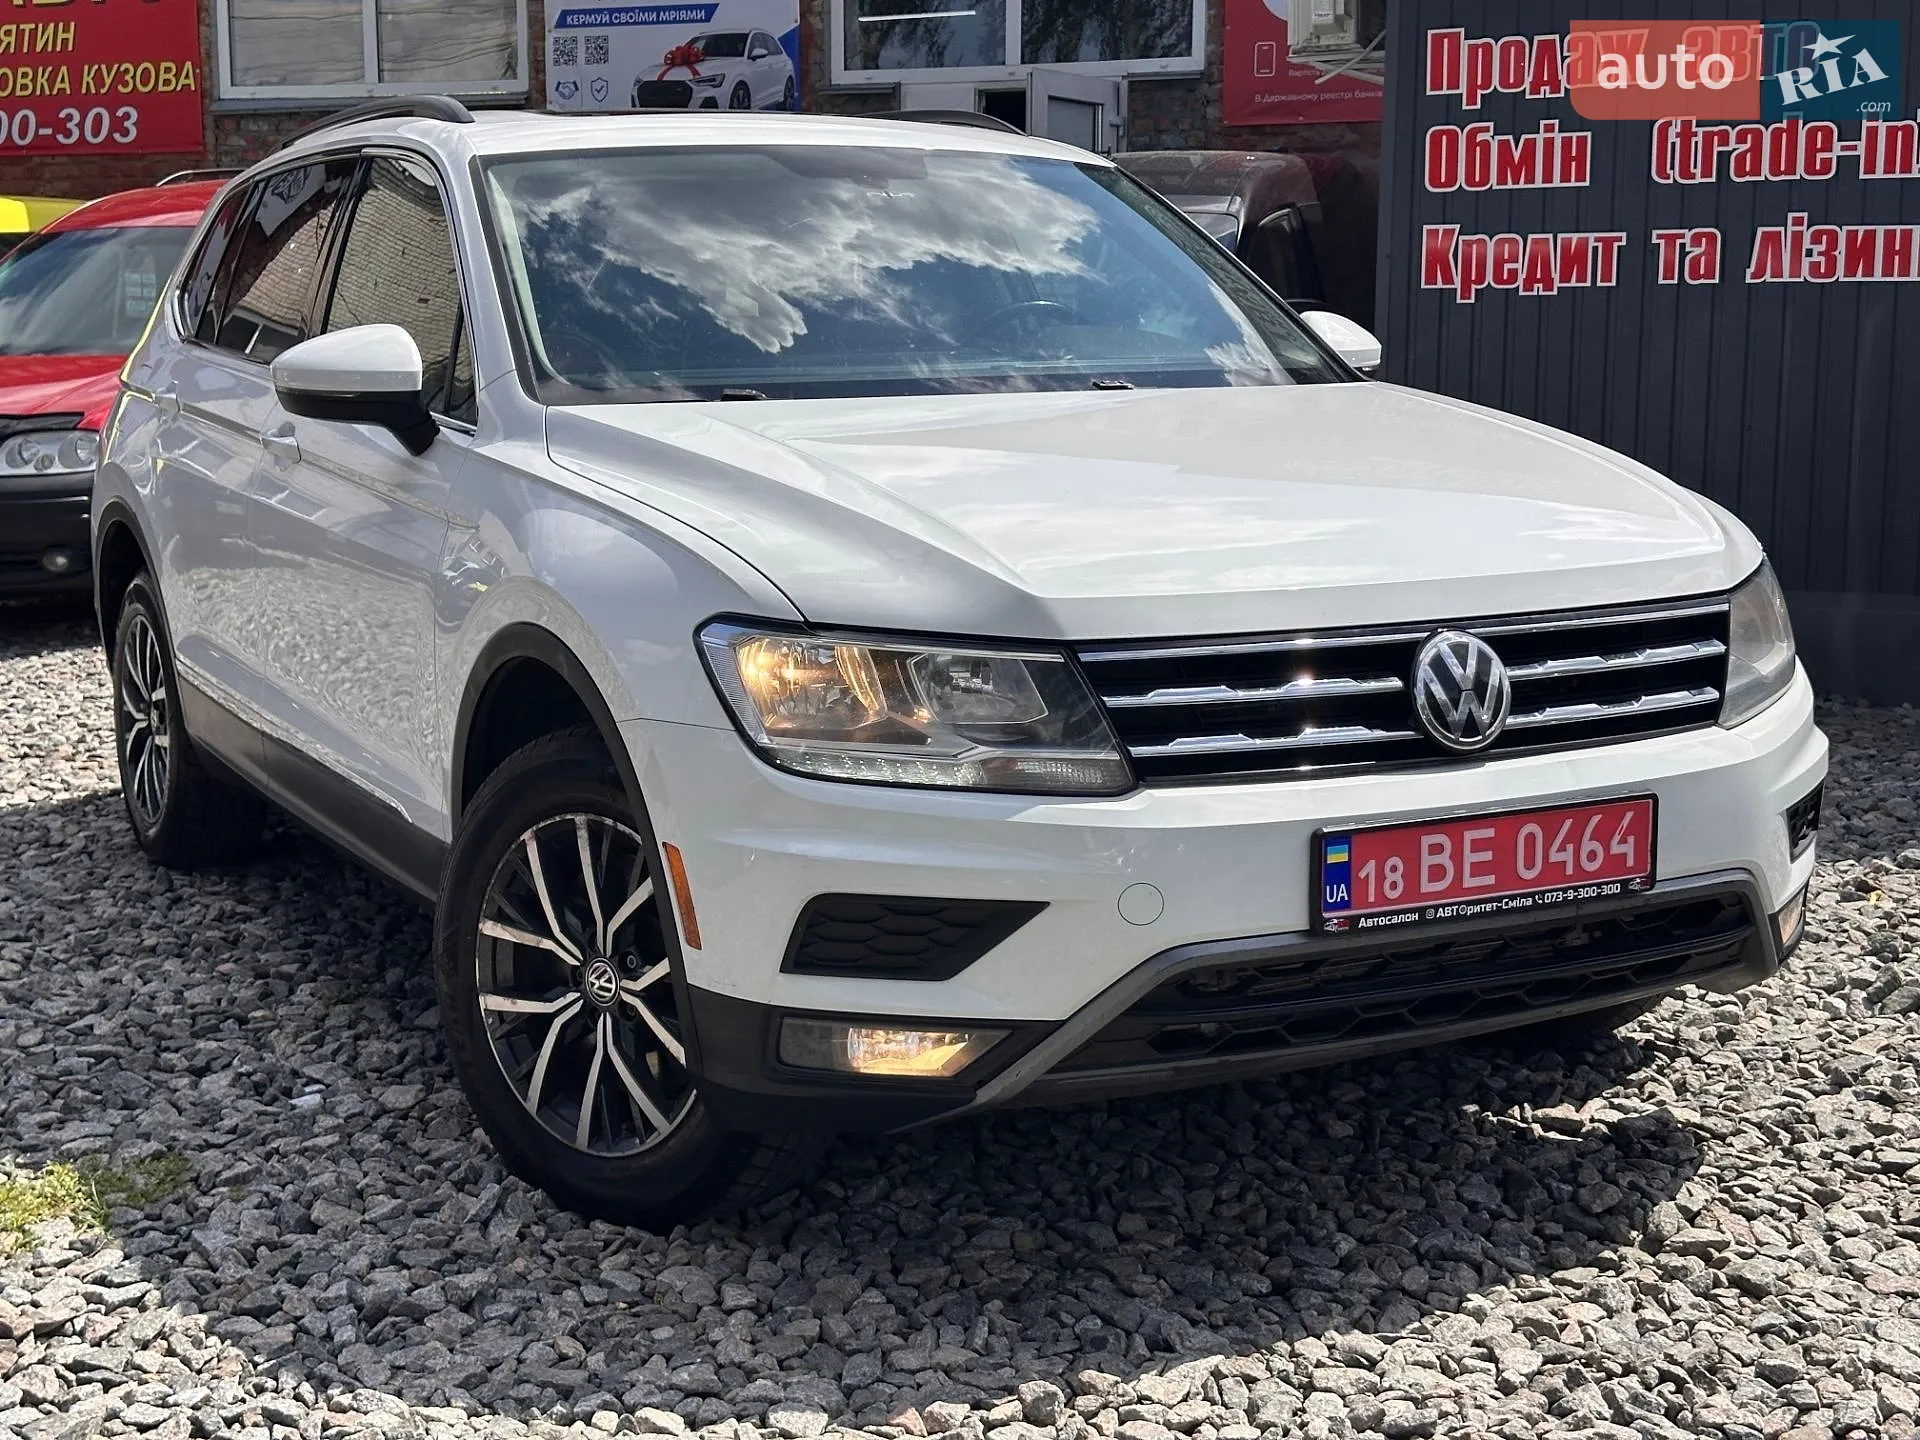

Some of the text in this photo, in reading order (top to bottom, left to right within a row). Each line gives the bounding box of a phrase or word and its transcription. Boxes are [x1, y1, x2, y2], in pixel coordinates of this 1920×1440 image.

[566, 9, 706, 25] КЕРМУЙ СВОЇМИ МРІЯМИ
[81, 60, 196, 95] КУЗОВА
[1263, 91, 1318, 103] Державному
[1426, 27, 1649, 109] Продаж
[1425, 119, 1592, 192] Обмін
[1651, 110, 1920, 185] (trade-in
[1421, 212, 1920, 304] Кредит та лізин
[1357, 810, 1636, 903] 18 BE 0464
[1326, 883, 1349, 904] UA
[1358, 912, 1419, 929] Автосалон
[1544, 883, 1621, 904] 073-9-300-300
